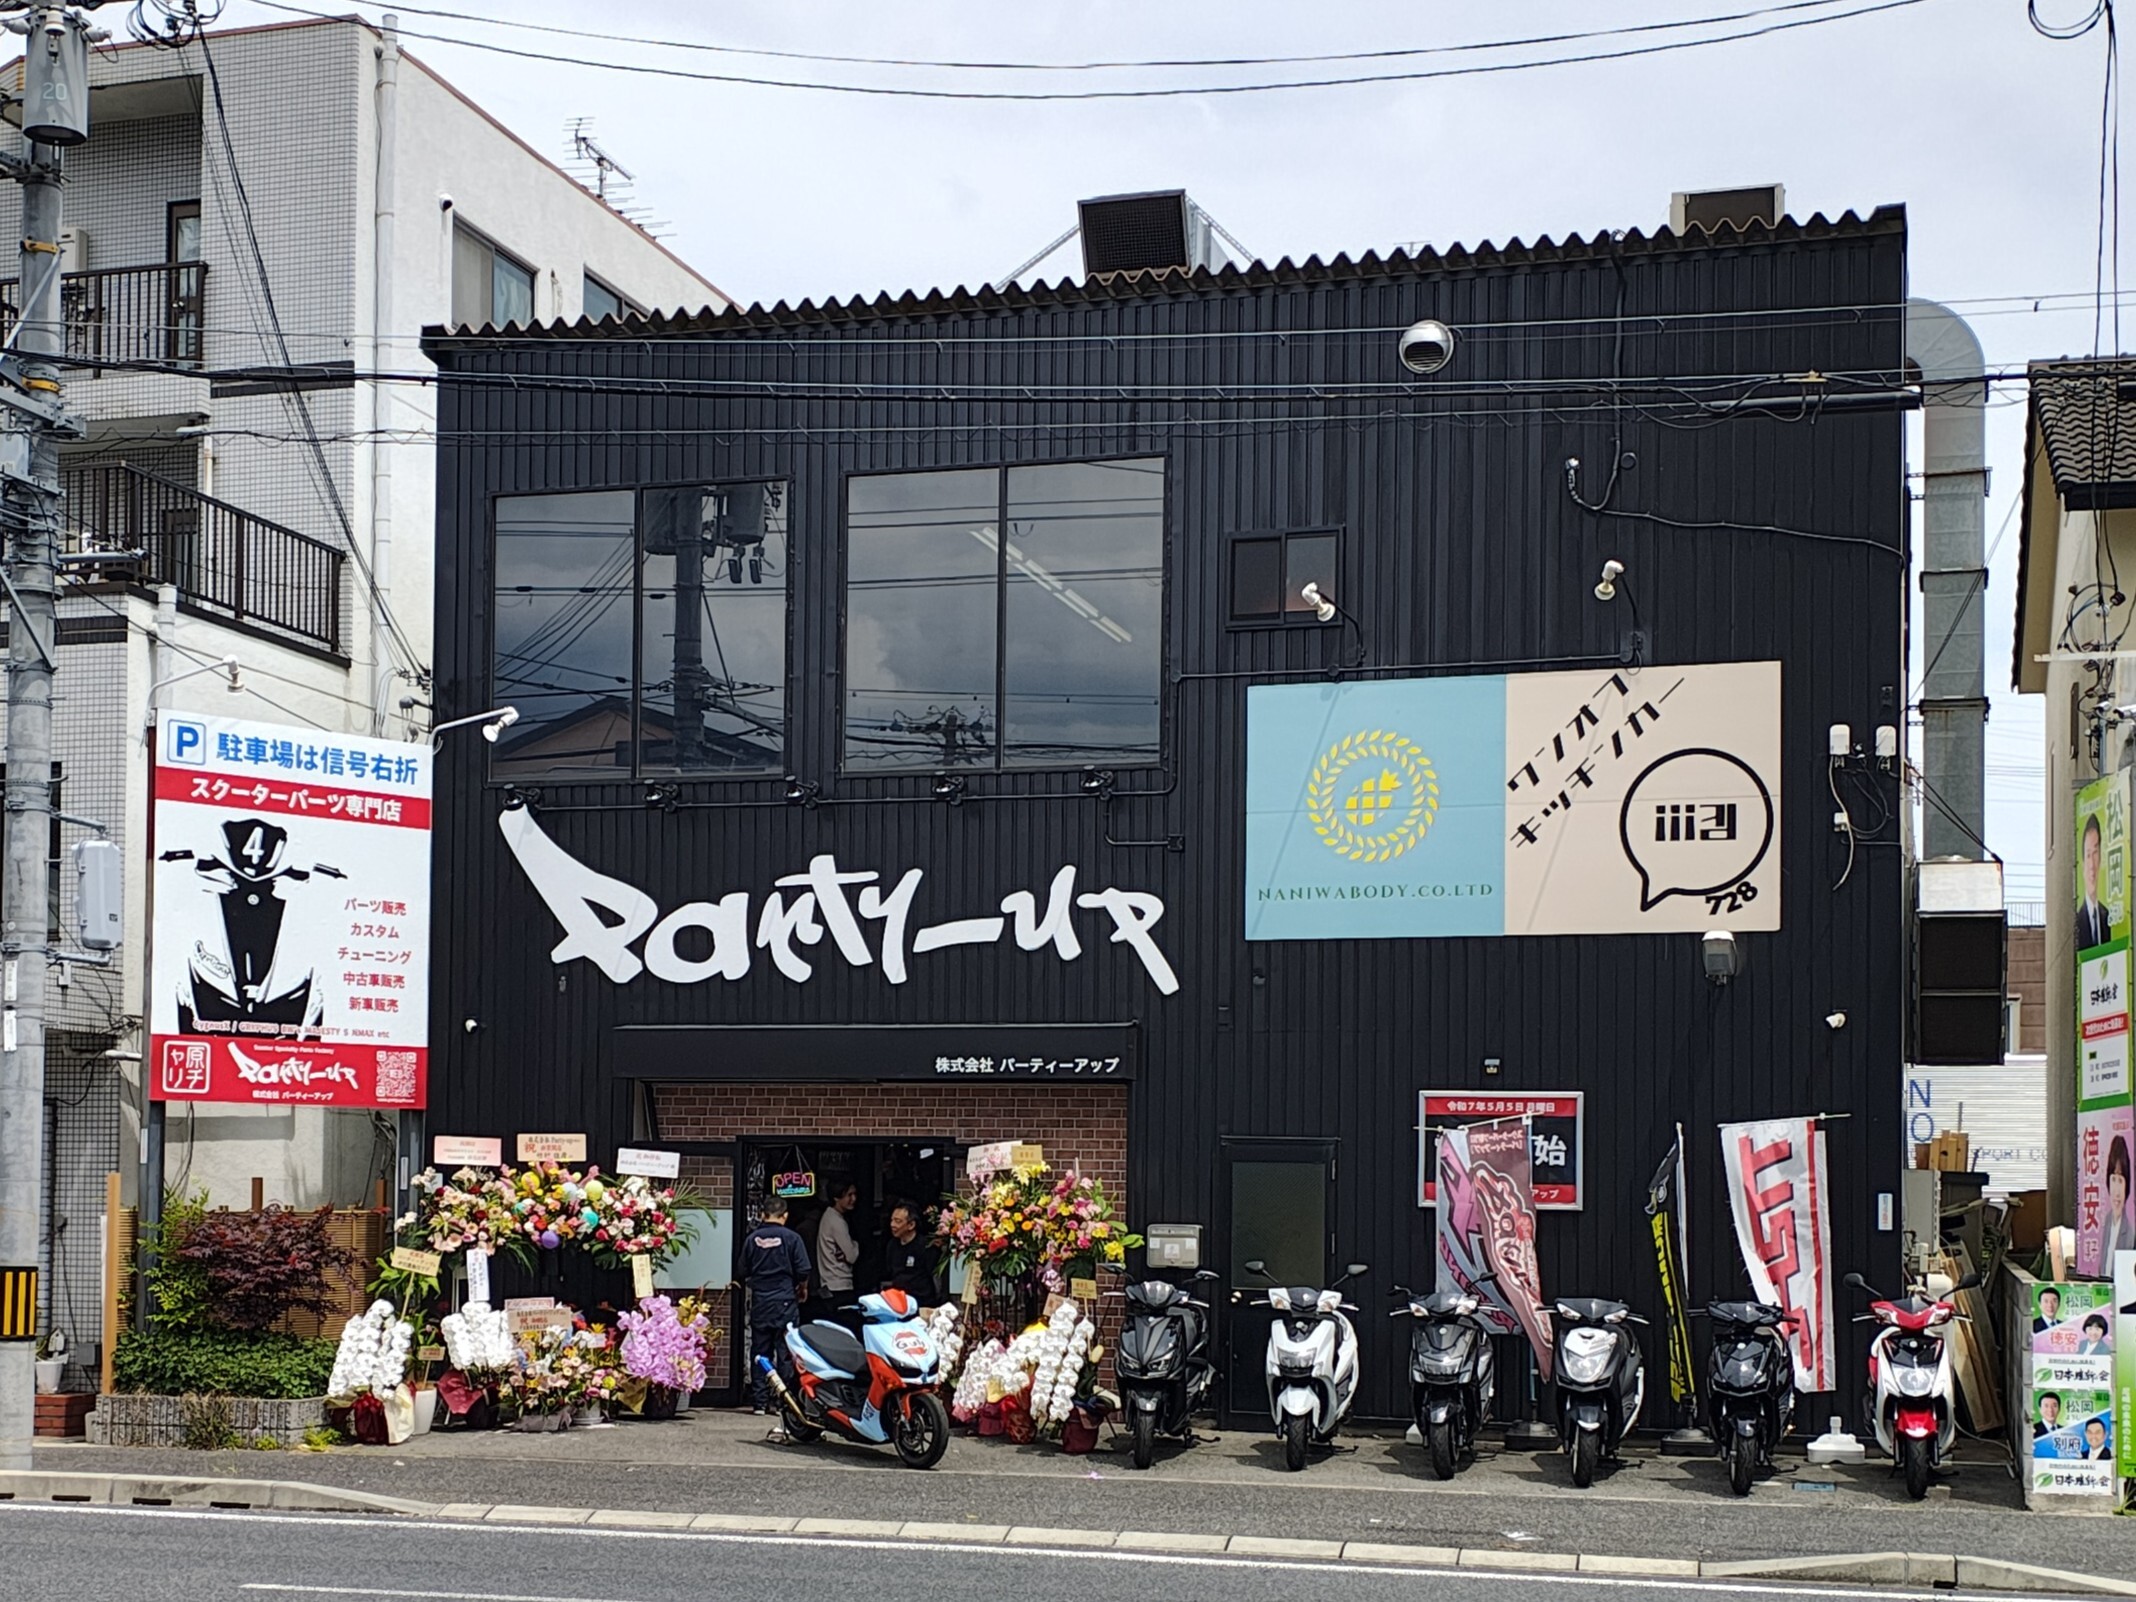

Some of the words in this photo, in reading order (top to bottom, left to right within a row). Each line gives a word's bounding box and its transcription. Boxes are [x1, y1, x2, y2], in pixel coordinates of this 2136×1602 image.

[43, 82, 67, 100] 20
[175, 726, 200, 757] P
[216, 732, 419, 785] 駐車場は信号右折
[191, 778, 402, 822] スクーターパーツ専門店
[1258, 884, 1494, 902] NANIWABODY.CO.LTD
[1705, 881, 1758, 916] 728
[344, 898, 407, 916] パーツ販売
[350, 923, 400, 939] カスタム
[337, 947, 412, 964] チューニング
[343, 972, 406, 989] 中古車販売
[349, 997, 399, 1013] 新車販売
[352, 1029, 374, 1037] NMAX
[934, 1056, 994, 1074] 株式会社
[999, 1056, 1120, 1074] パーティーアップ
[776, 1172, 811, 1187] OPEN
[2065, 1295, 2093, 1308] 松岡
[2050, 1332, 2078, 1345] 徳安
[2066, 1400, 2094, 1413] 松岡
[2054, 1436, 2081, 1450] 別府
